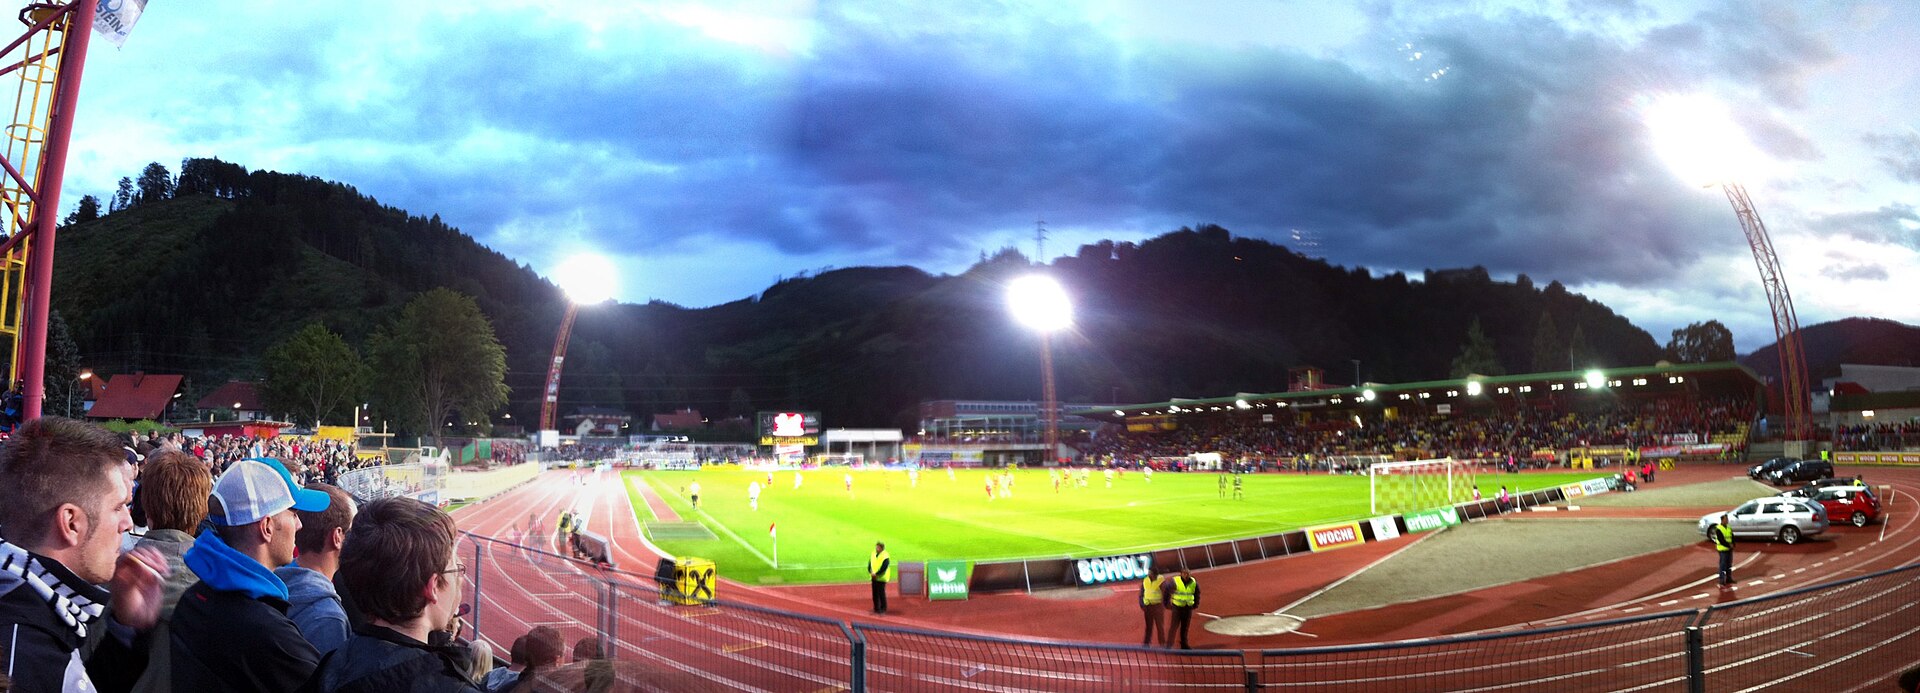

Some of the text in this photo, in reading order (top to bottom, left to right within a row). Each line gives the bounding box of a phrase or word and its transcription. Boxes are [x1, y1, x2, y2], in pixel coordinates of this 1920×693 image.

[1405, 514, 1442, 531] erima
[1314, 527, 1356, 546] WOCHE
[1077, 555, 1152, 584] SCHOLZ
